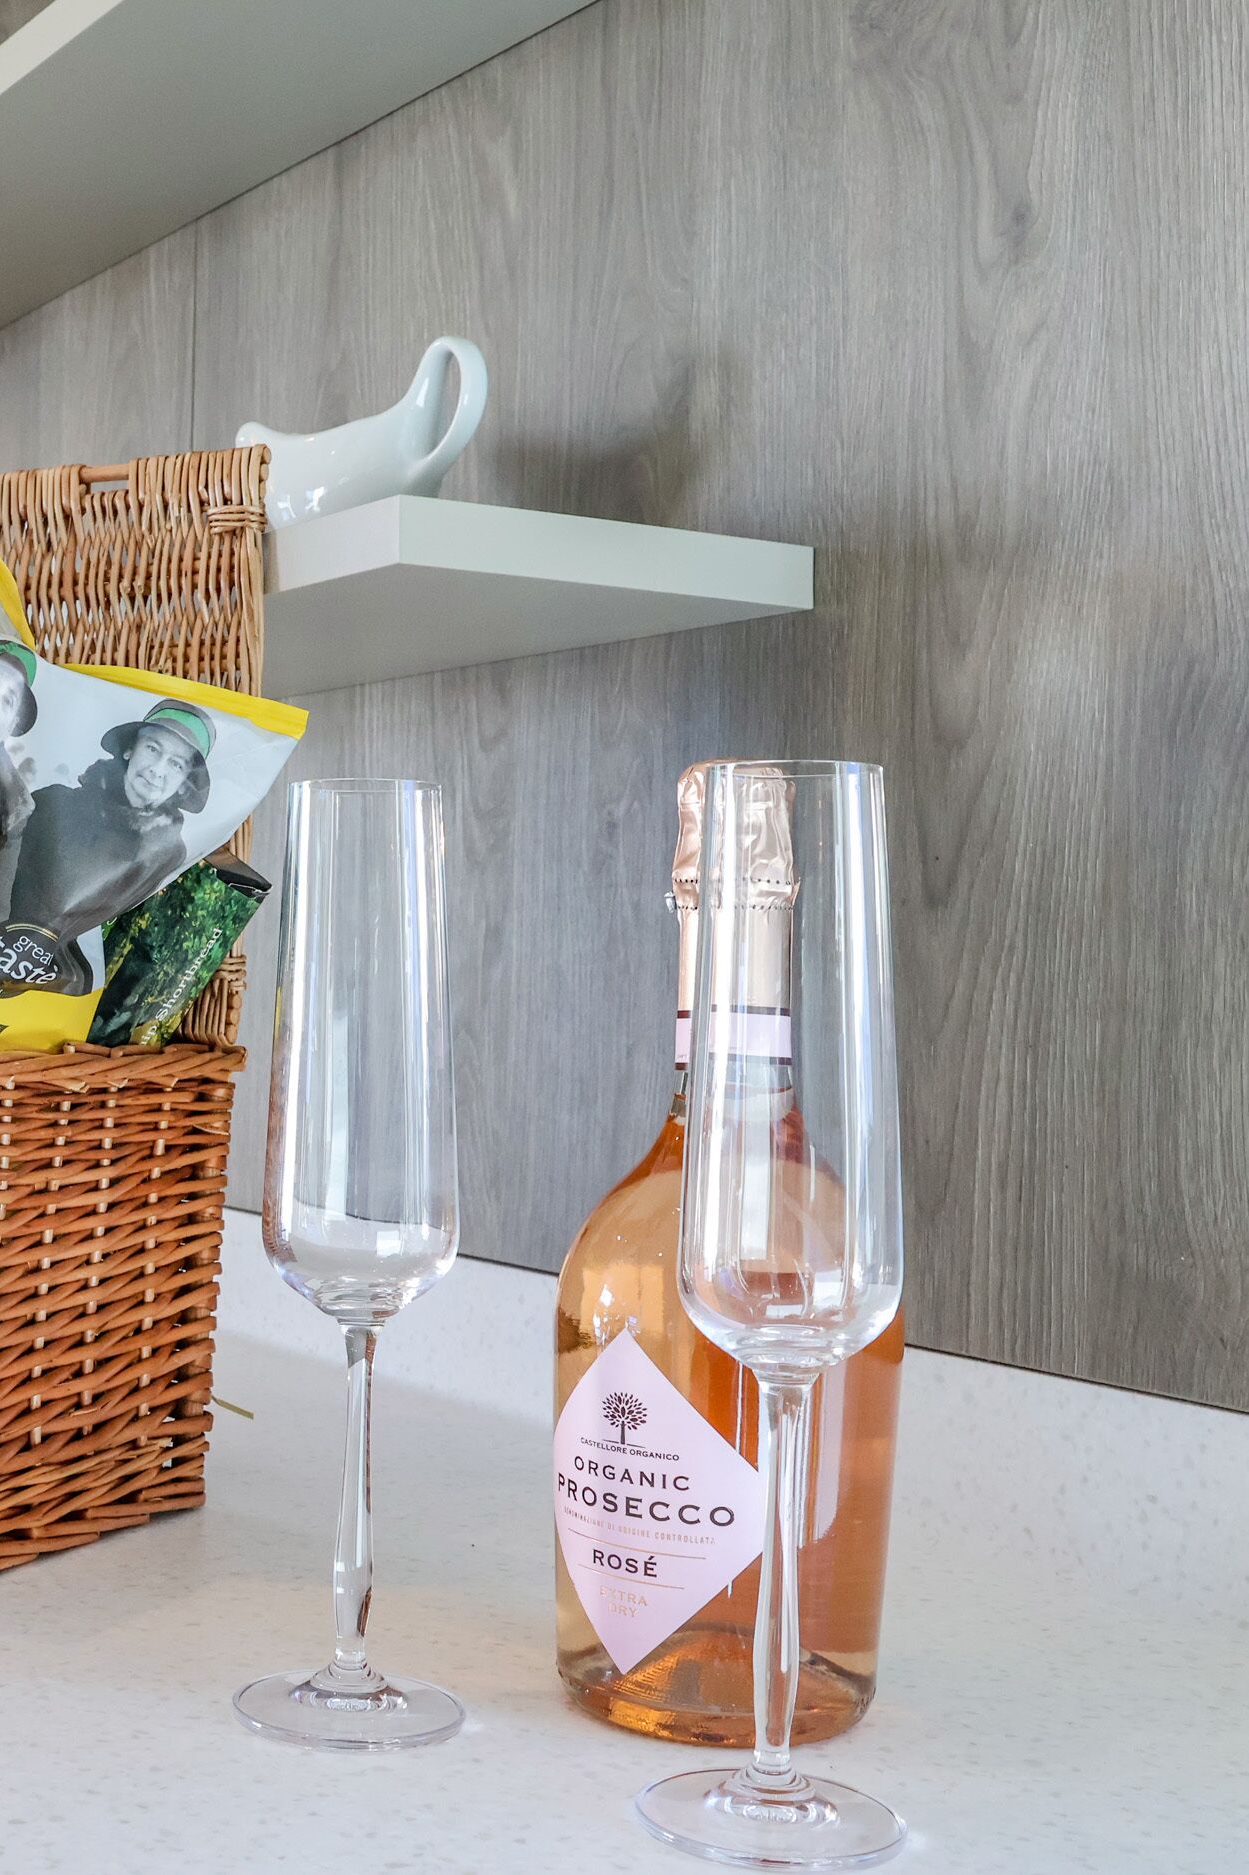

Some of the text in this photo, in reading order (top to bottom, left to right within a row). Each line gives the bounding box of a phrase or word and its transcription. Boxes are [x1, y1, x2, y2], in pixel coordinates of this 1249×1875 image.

[155, 927, 223, 1022] Shortbread
[580, 1436, 680, 1461] CASTELLORE ORGANICO
[574, 1455, 691, 1492] ORGANIC
[557, 1471, 736, 1528] PROSECCO
[654, 1532, 716, 1546] CONTROLLATA
[592, 1548, 658, 1579] ROSÉ
[599, 1585, 648, 1607] EXTRA
[607, 1601, 637, 1618] DRY
